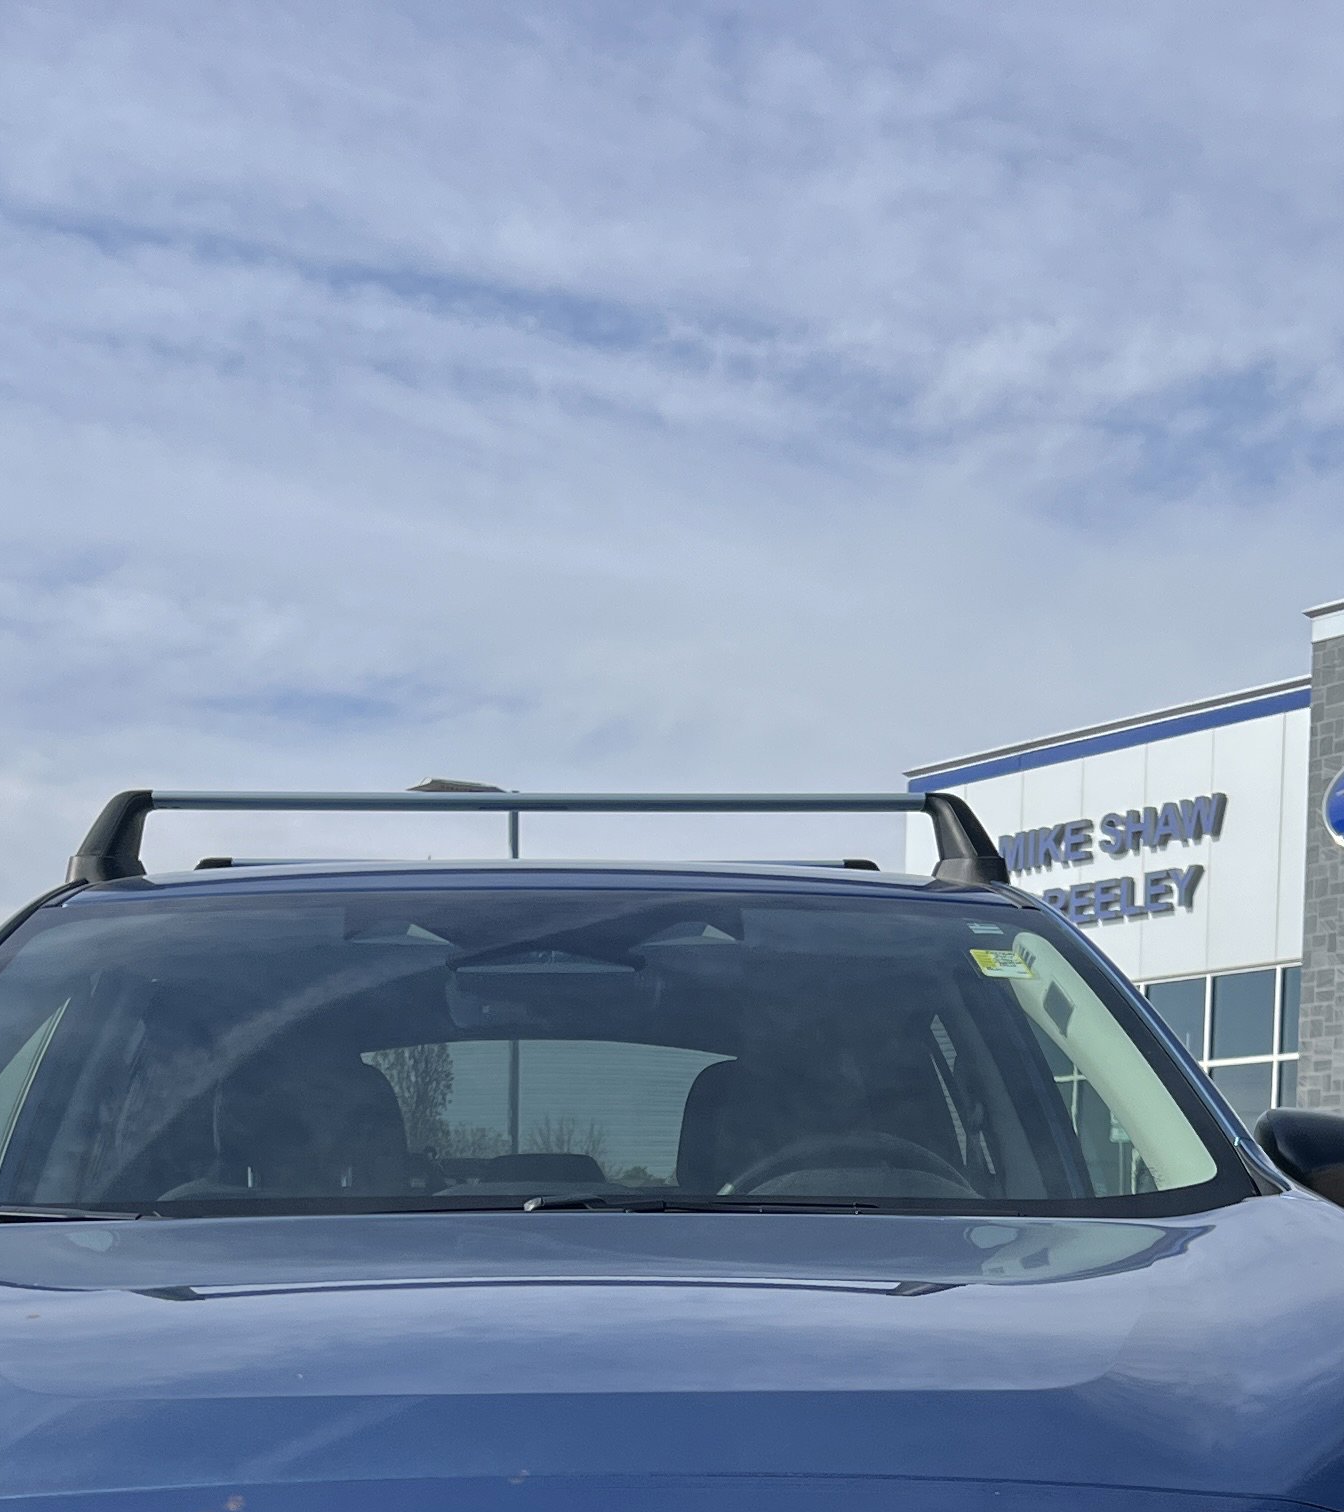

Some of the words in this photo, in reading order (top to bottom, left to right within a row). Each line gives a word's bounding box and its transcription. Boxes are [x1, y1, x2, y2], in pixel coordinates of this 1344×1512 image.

[998, 819, 1094, 875] MIKE
[1099, 792, 1227, 859] SHAW
[1039, 865, 1204, 927] REELEY
